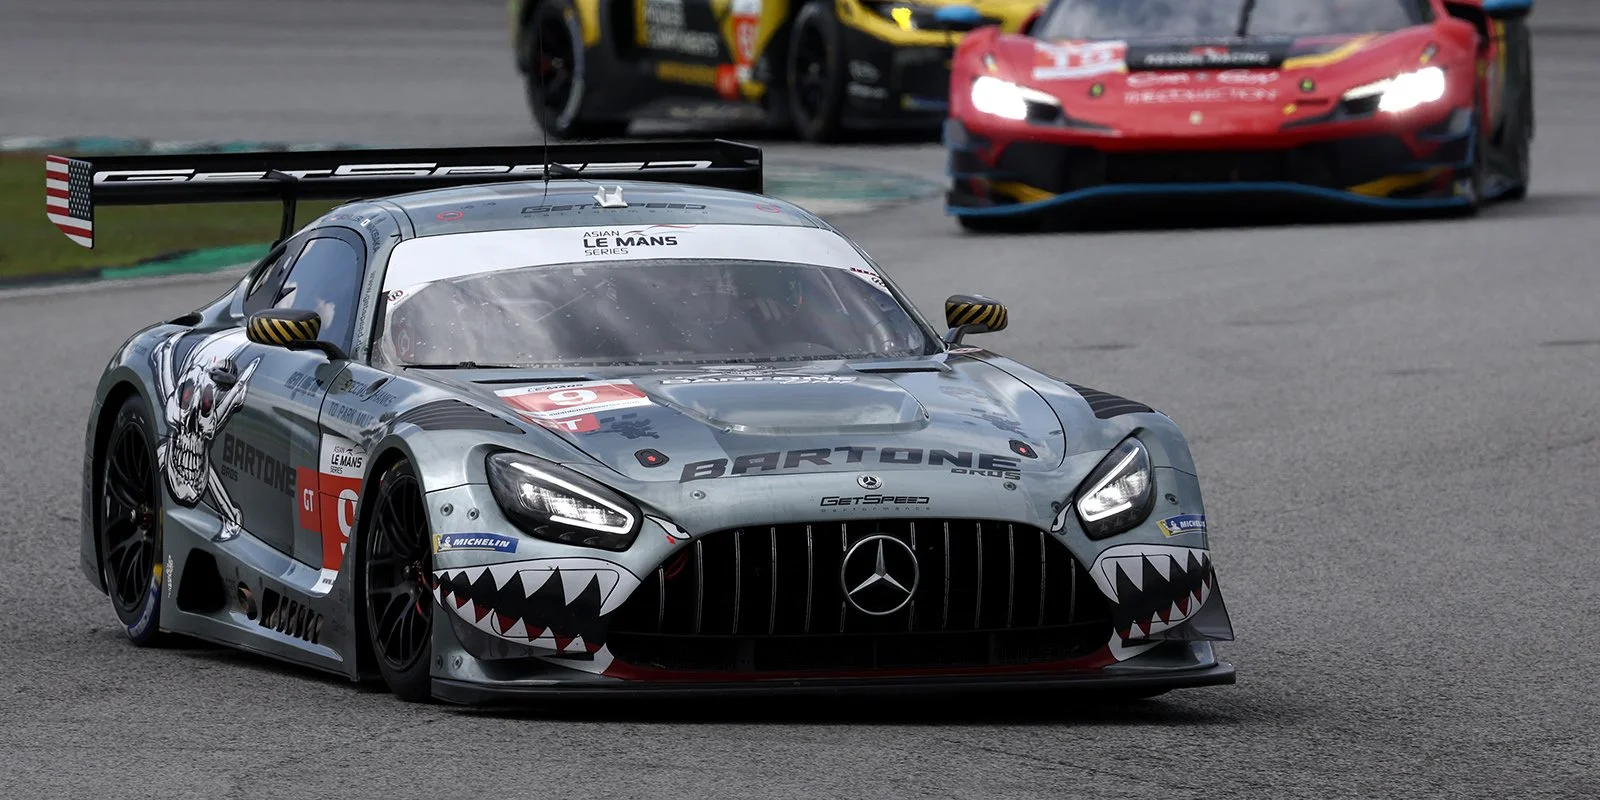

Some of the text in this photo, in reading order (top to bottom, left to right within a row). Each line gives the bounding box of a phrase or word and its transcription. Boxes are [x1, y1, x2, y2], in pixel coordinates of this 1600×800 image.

[583, 230, 620, 238] ASIAN
[584, 236, 678, 248] LE MANS
[585, 248, 629, 256] SERIES
[548, 389, 598, 406] 9
[223, 432, 297, 498] BARTONE
[331, 453, 363, 469] LE MANS
[679, 446, 1021, 484] BARTONE
[303, 488, 314, 513] GT
[453, 537, 510, 548] MICHELIN
